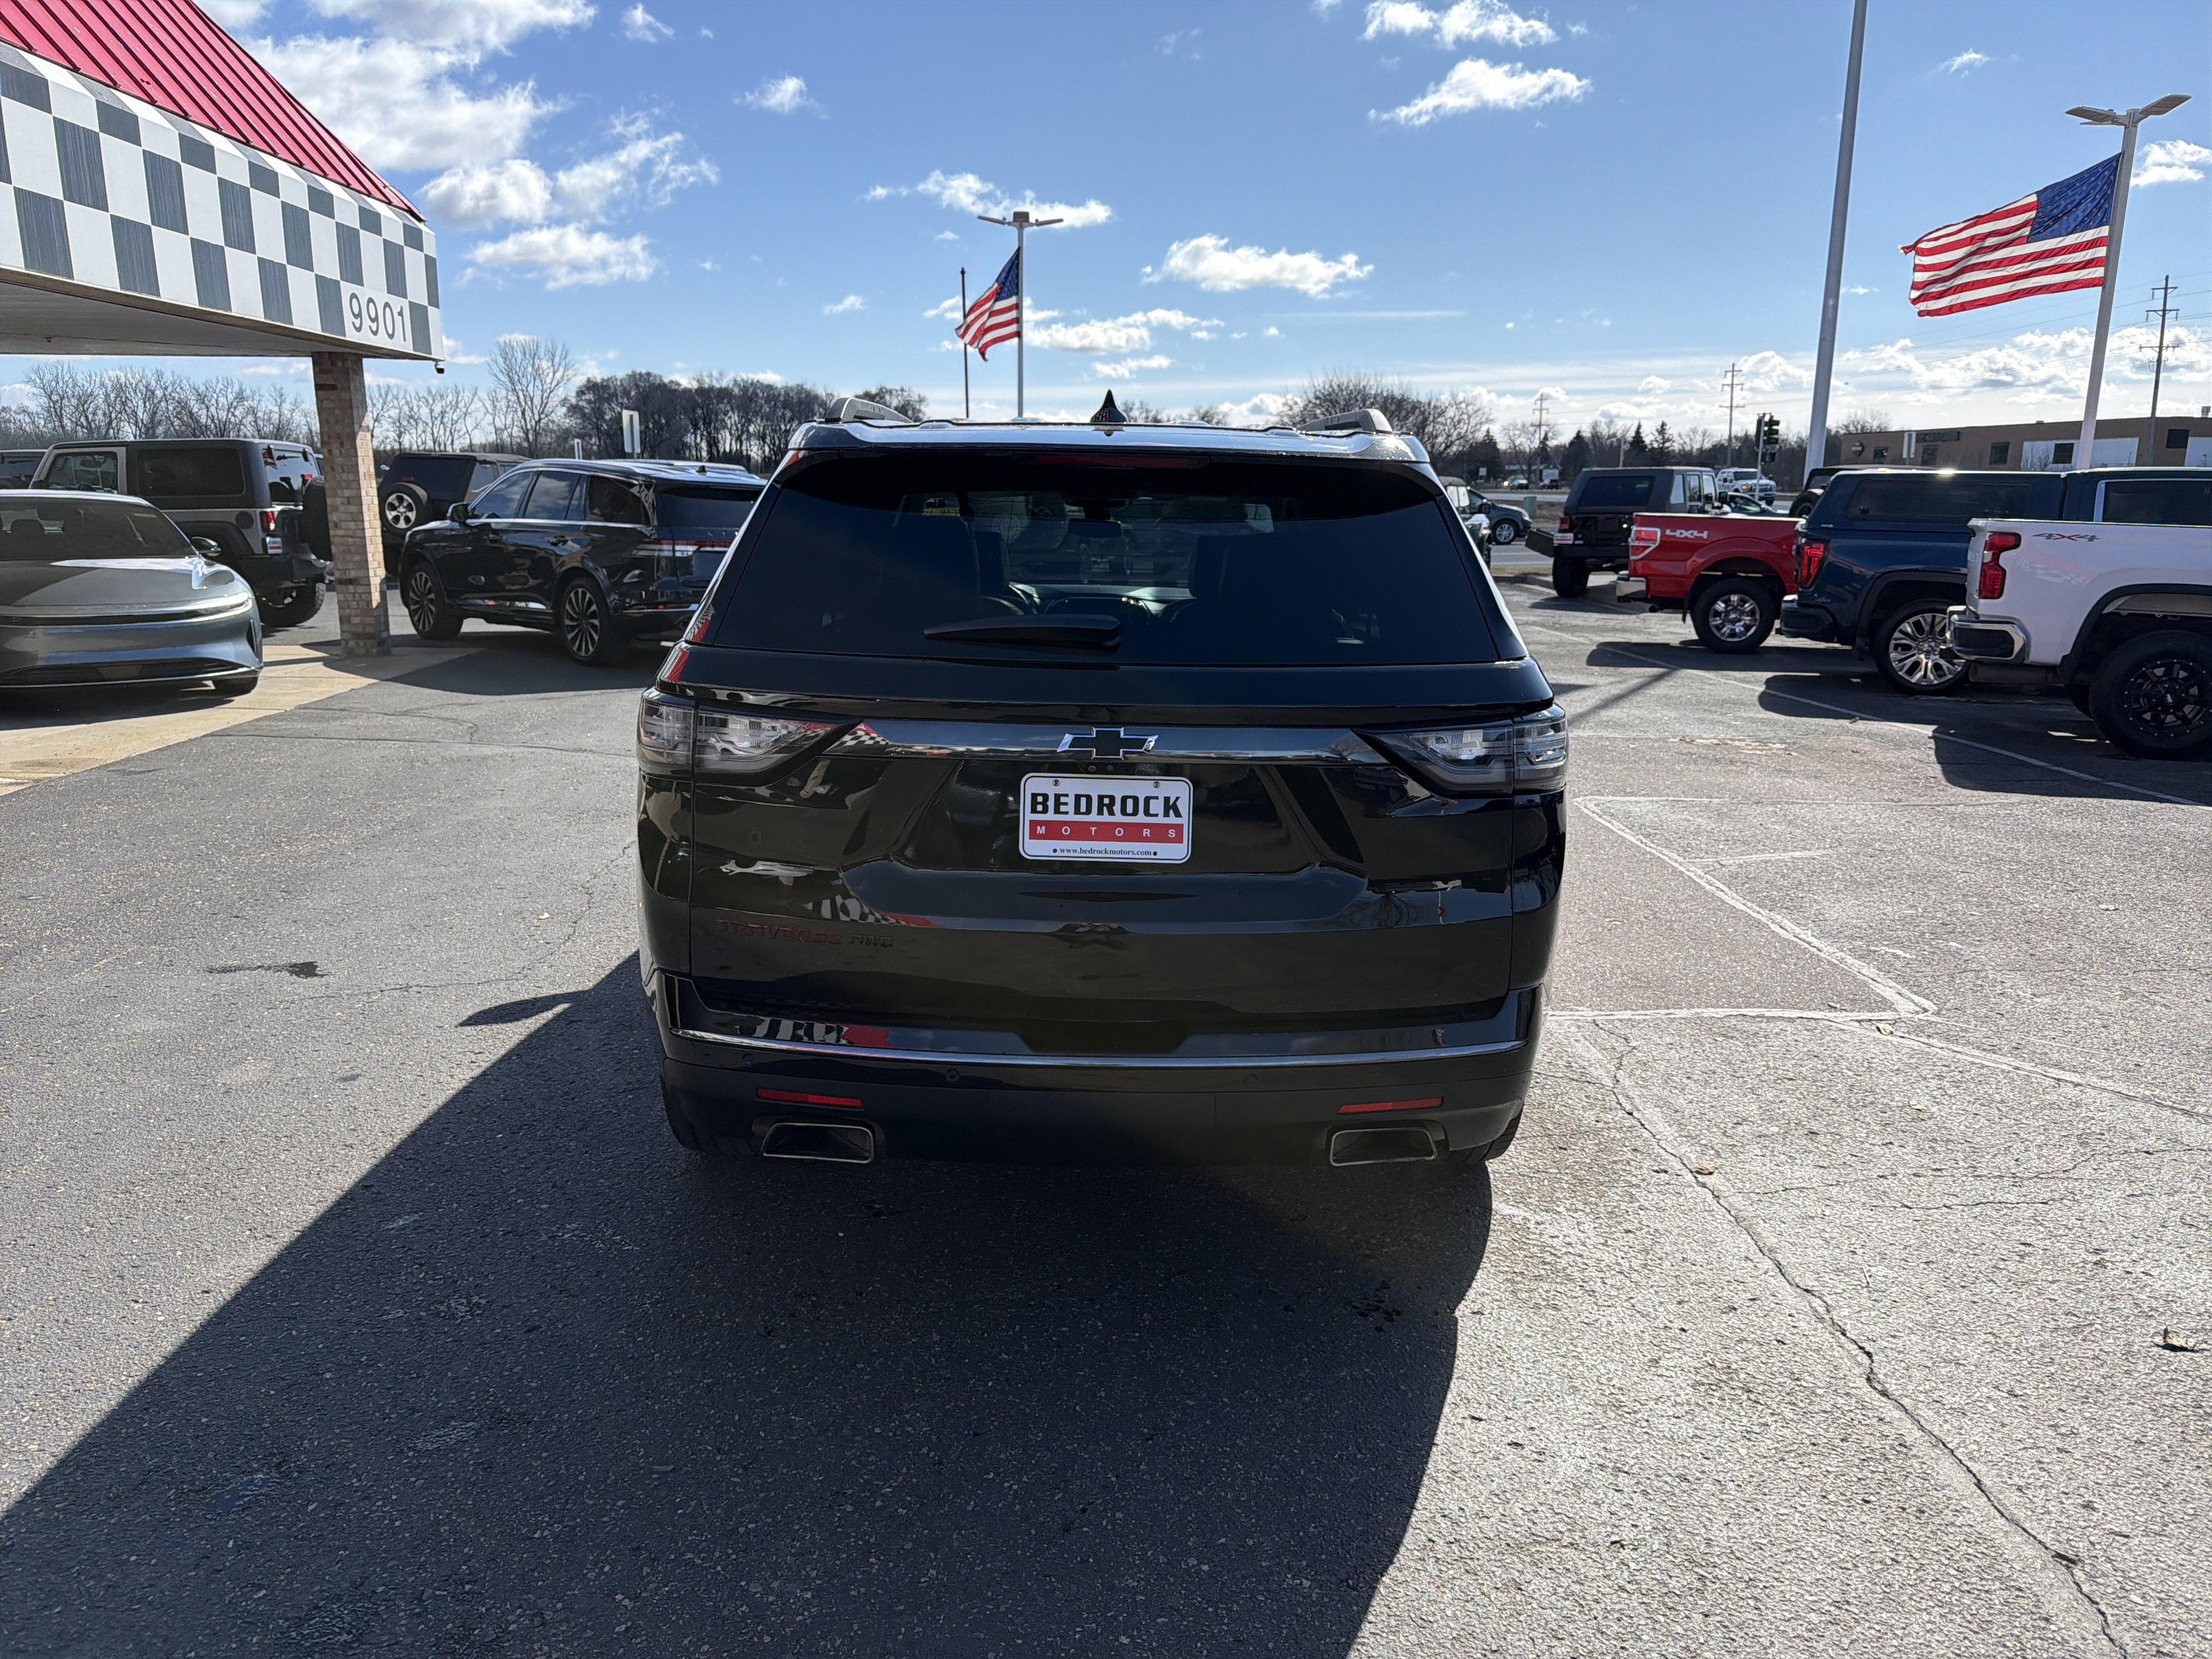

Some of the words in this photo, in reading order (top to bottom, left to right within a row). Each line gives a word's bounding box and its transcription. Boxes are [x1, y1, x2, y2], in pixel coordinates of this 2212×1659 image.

[349, 292, 407, 342] 9901
[1030, 792, 1183, 818] BEDROCK
[1036, 826, 1176, 837] MOTORS
[1059, 847, 1152, 856] www.bedrockmotors.com
[716, 918, 843, 944] TRAVERSE
[850, 934, 894, 948] AWD
